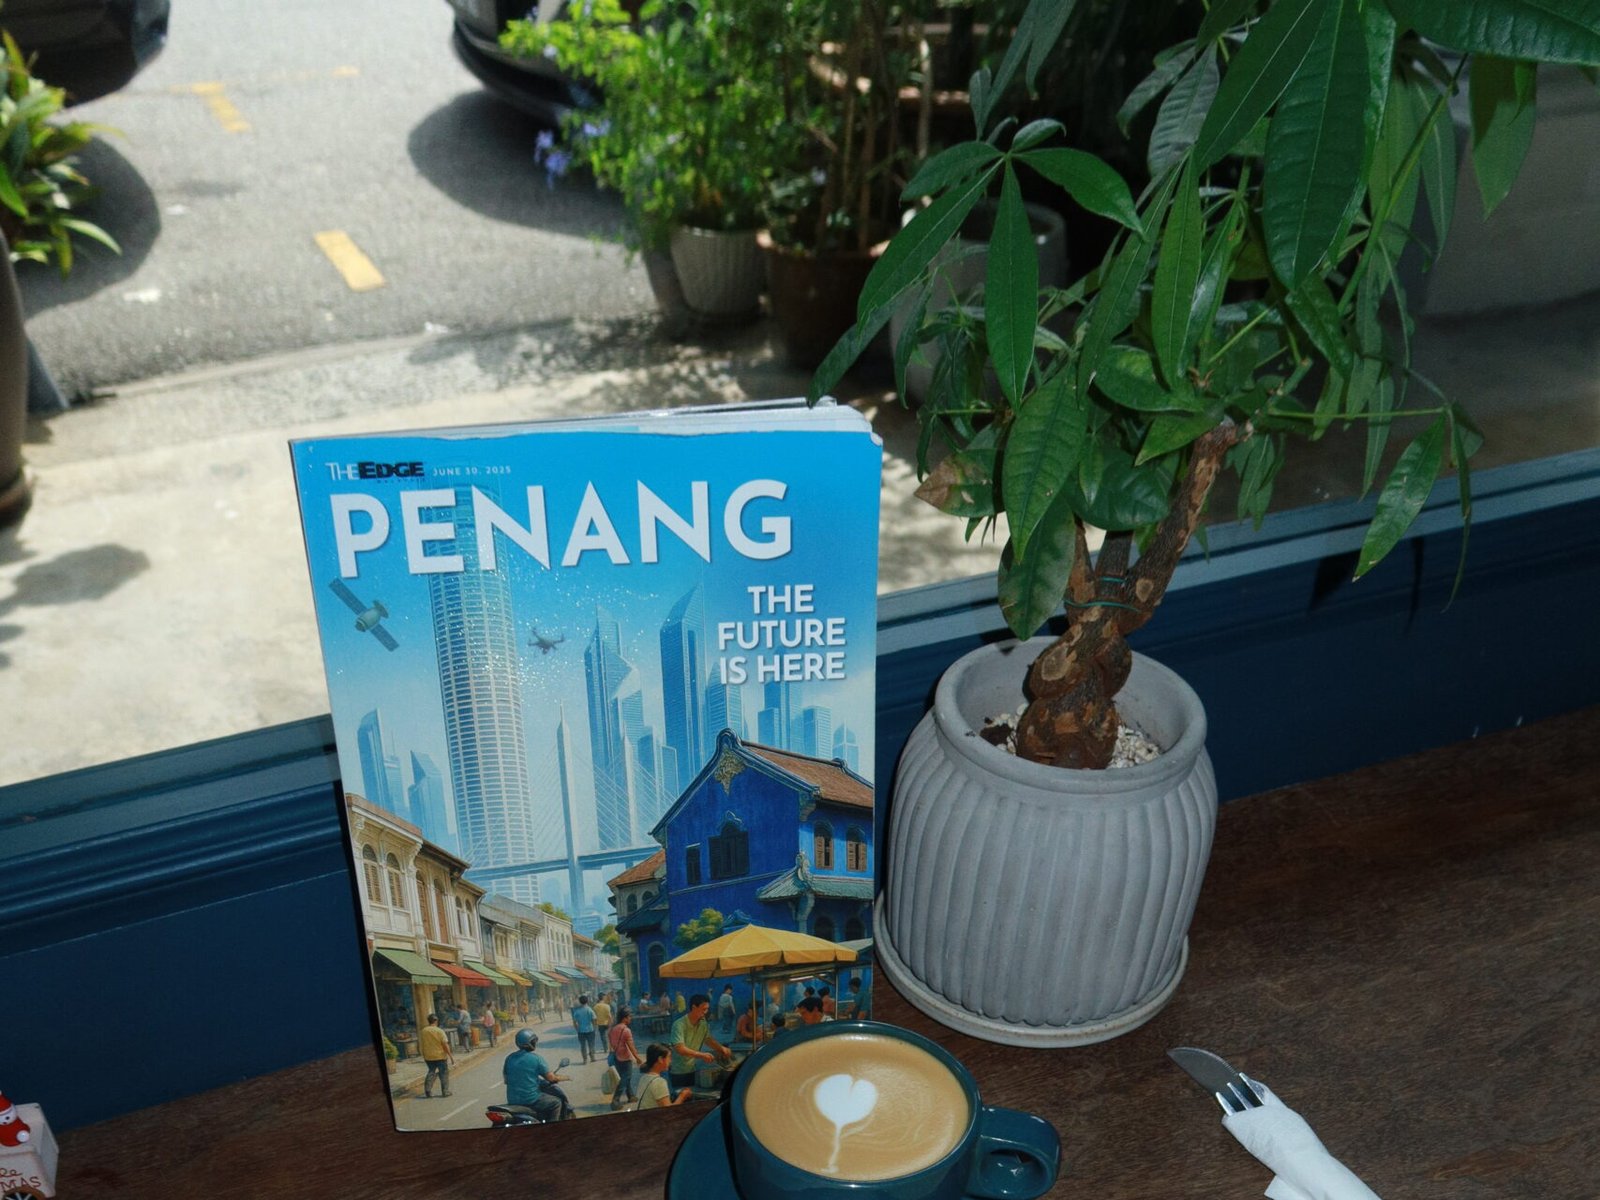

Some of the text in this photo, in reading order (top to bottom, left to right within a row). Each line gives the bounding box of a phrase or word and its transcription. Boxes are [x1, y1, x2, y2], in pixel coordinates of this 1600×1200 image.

[433, 466, 461, 477] JUNE
[486, 465, 512, 475] 2025
[329, 478, 792, 579] PENANG
[747, 583, 815, 614] THE
[717, 617, 847, 650] FUTURE
[719, 651, 846, 685] IS HERE
